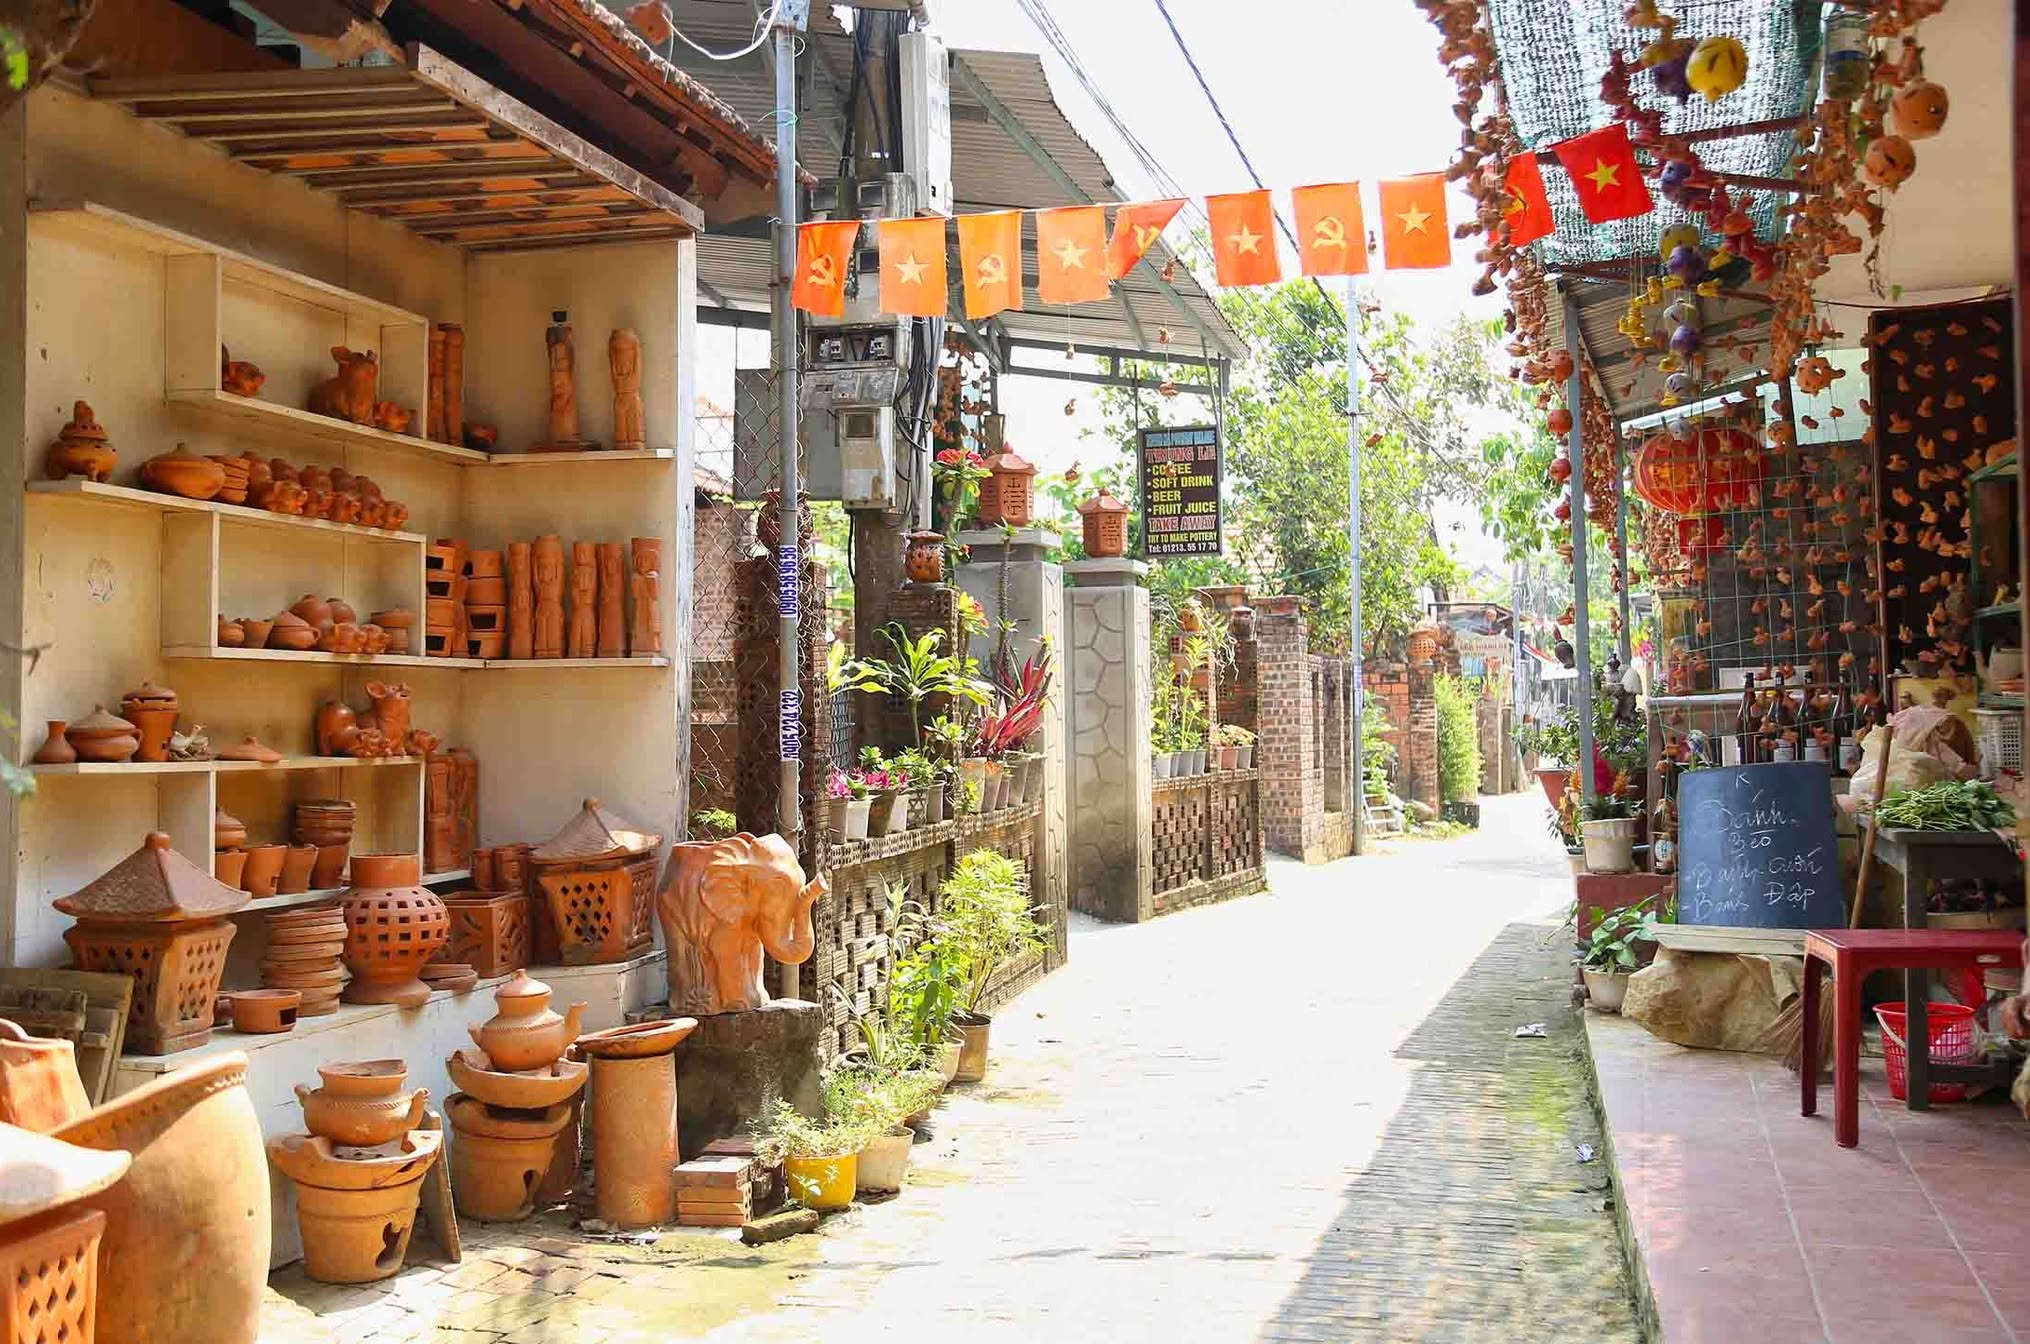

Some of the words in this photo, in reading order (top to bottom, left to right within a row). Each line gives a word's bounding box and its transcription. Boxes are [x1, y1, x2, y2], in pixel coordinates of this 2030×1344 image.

[1152, 463, 1192, 476] COFEE
[1152, 477, 1178, 489] SOFT
[1181, 475, 1214, 488] DRINK
[1152, 490, 1181, 502] BEER
[1152, 503, 1182, 515] FRUIT
[1185, 501, 1217, 514] JUICE
[1148, 517, 1179, 532] TAKE
[1180, 515, 1217, 531] AWAY
[1148, 535, 1160, 544] TRY
[1161, 534, 1169, 543] TO
[1170, 533, 1189, 543] MAKE
[1190, 532, 1217, 542] POTTERY
